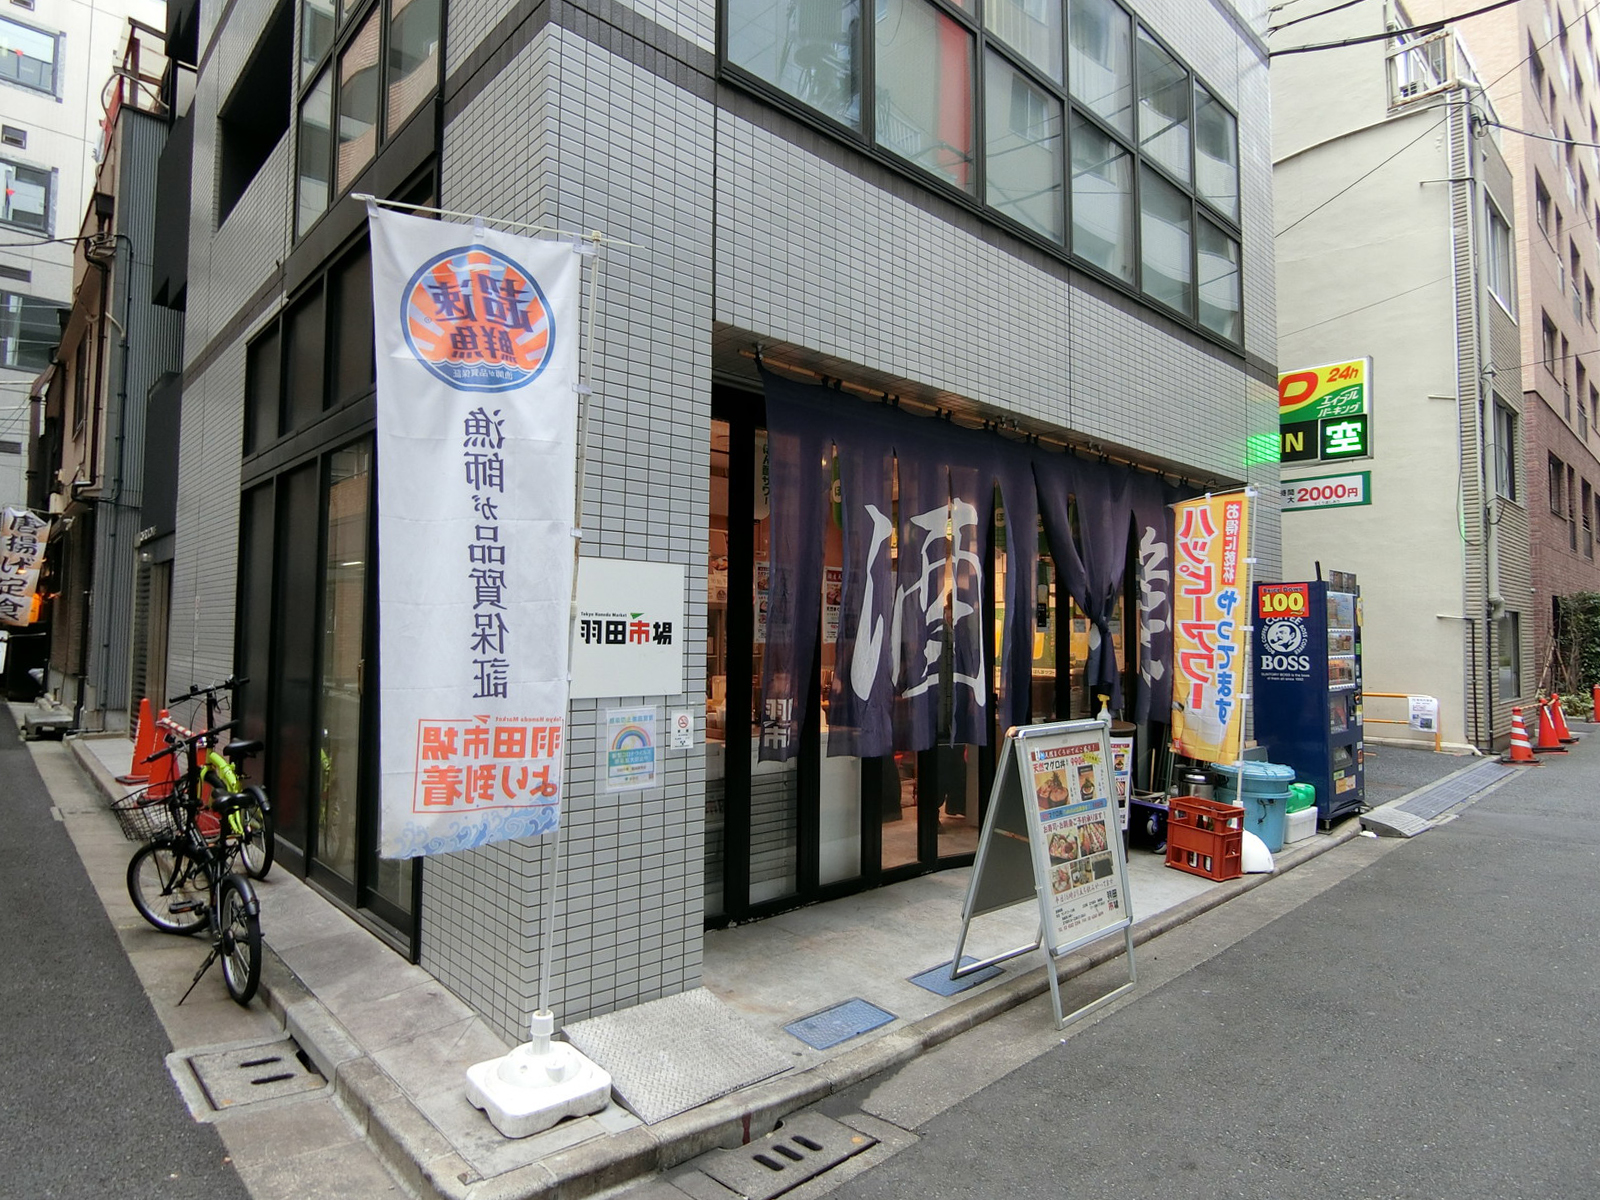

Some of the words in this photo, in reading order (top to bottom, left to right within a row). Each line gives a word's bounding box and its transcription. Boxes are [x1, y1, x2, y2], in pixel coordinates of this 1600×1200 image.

[1327, 366, 1359, 383] 24h
[1321, 387, 1360, 406] エイブル
[1316, 402, 1361, 418] パーキング
[1326, 421, 1362, 453] 空
[1297, 484, 1358, 502] 2000円
[0, 515, 39, 621] 唐揚げ定食
[850, 497, 986, 706] 酒
[1262, 593, 1304, 612] 100
[580, 620, 672, 645] 羽田市場
[1261, 655, 1310, 671] BOSS
